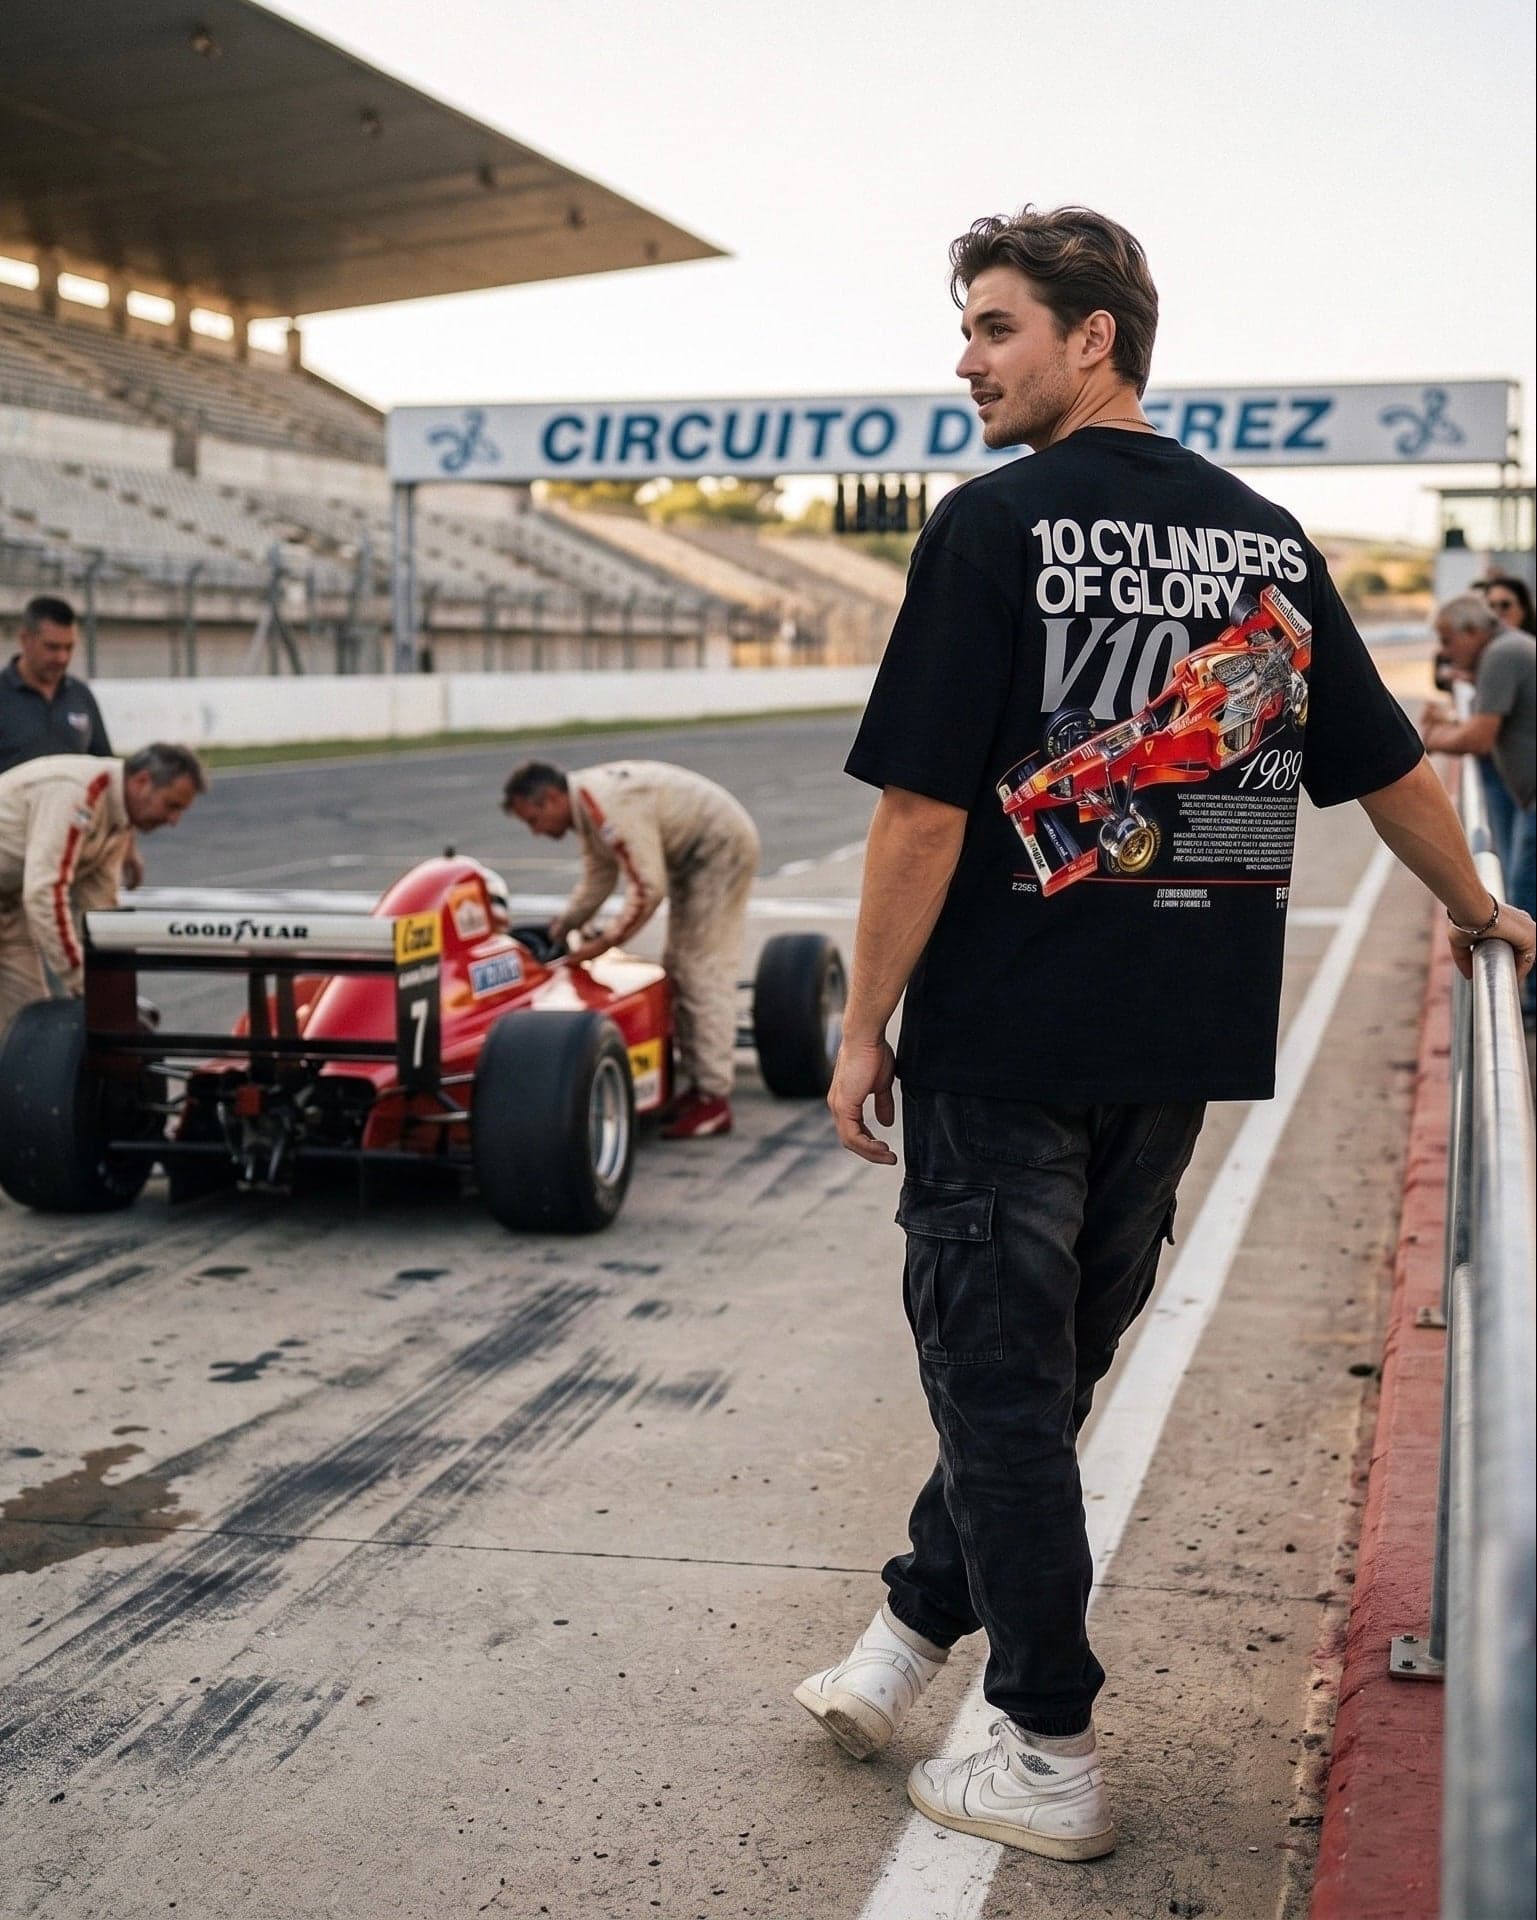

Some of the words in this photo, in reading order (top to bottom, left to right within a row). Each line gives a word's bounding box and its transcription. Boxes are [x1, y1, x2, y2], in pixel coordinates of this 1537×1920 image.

[541, 405, 899, 465] CIRCUITO
[1031, 519, 1086, 565] 10
[1090, 519, 1308, 583] CYLINDERS
[1036, 566, 1102, 615] OF
[1110, 567, 1245, 619] GLORY
[1040, 617, 1190, 720] V10
[1238, 749, 1303, 790] 1989
[168, 919, 309, 944] GOODYEAR
